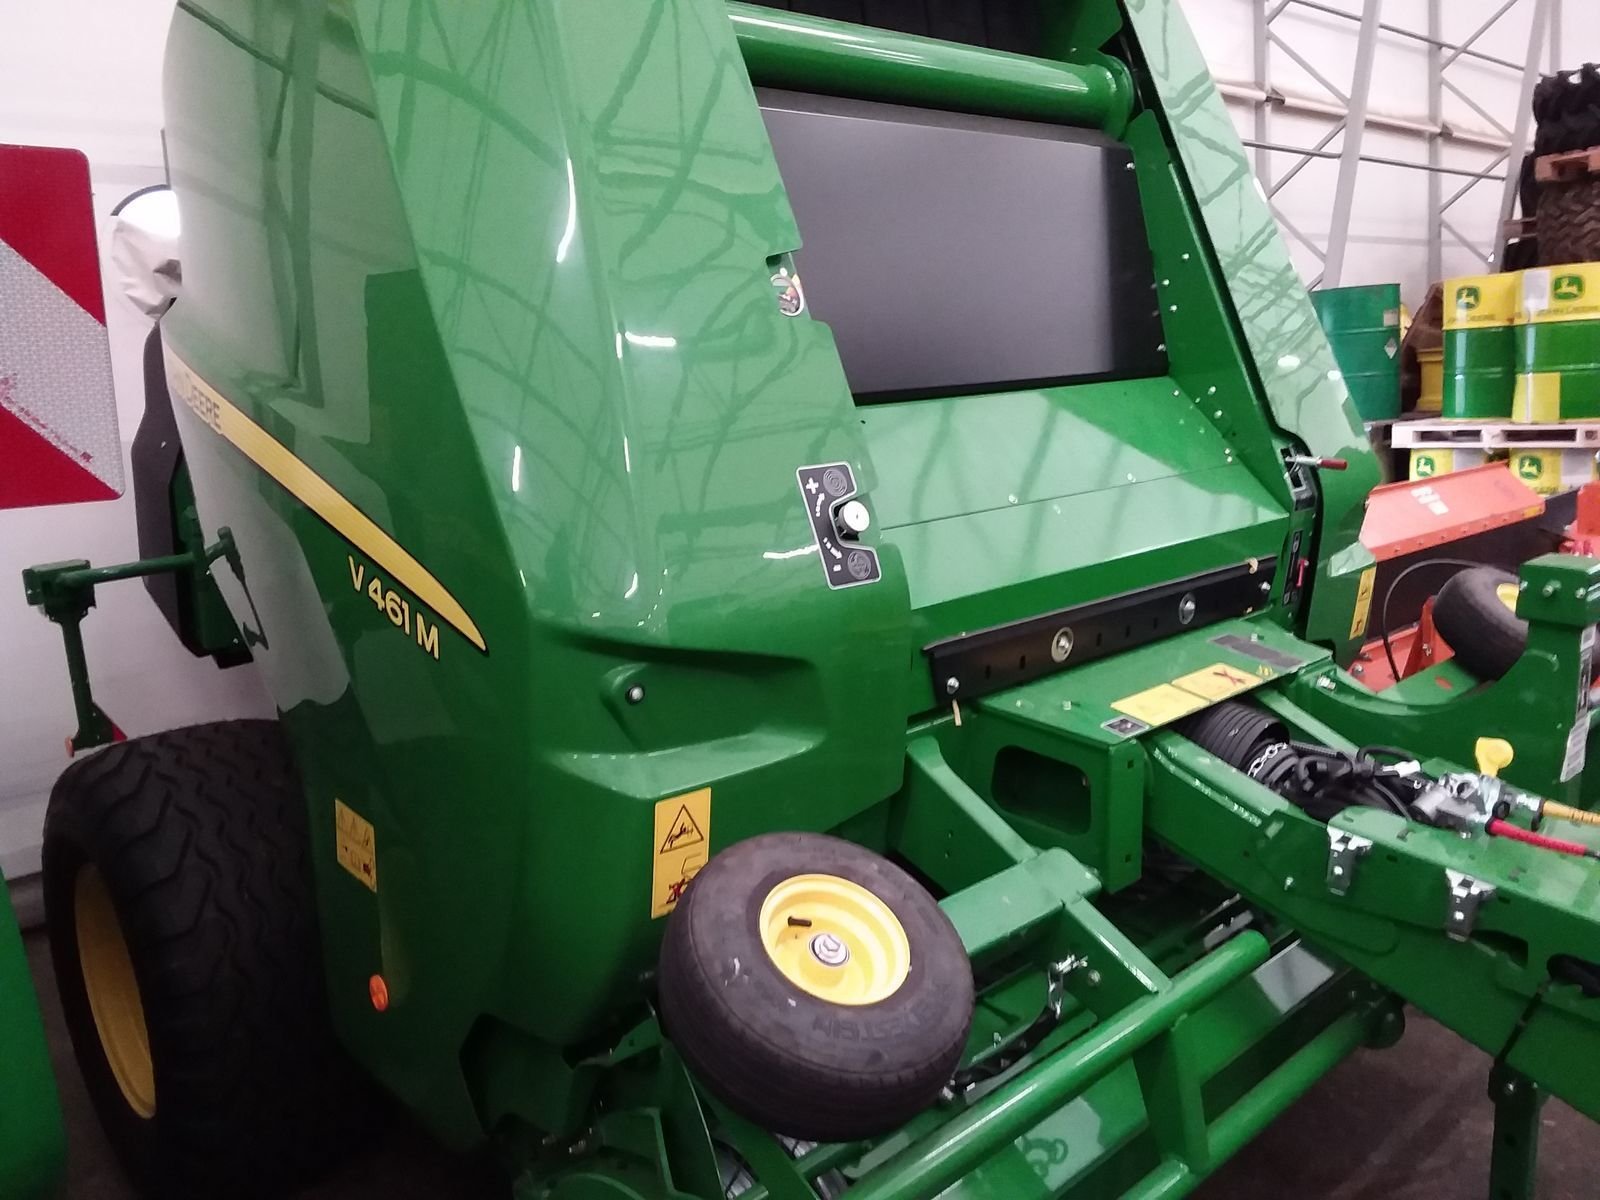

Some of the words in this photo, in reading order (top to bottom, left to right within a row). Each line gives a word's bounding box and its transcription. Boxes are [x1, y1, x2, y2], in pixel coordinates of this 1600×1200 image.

[348, 554, 365, 592] V
[368, 577, 410, 636] 461
[416, 611, 440, 660] M
